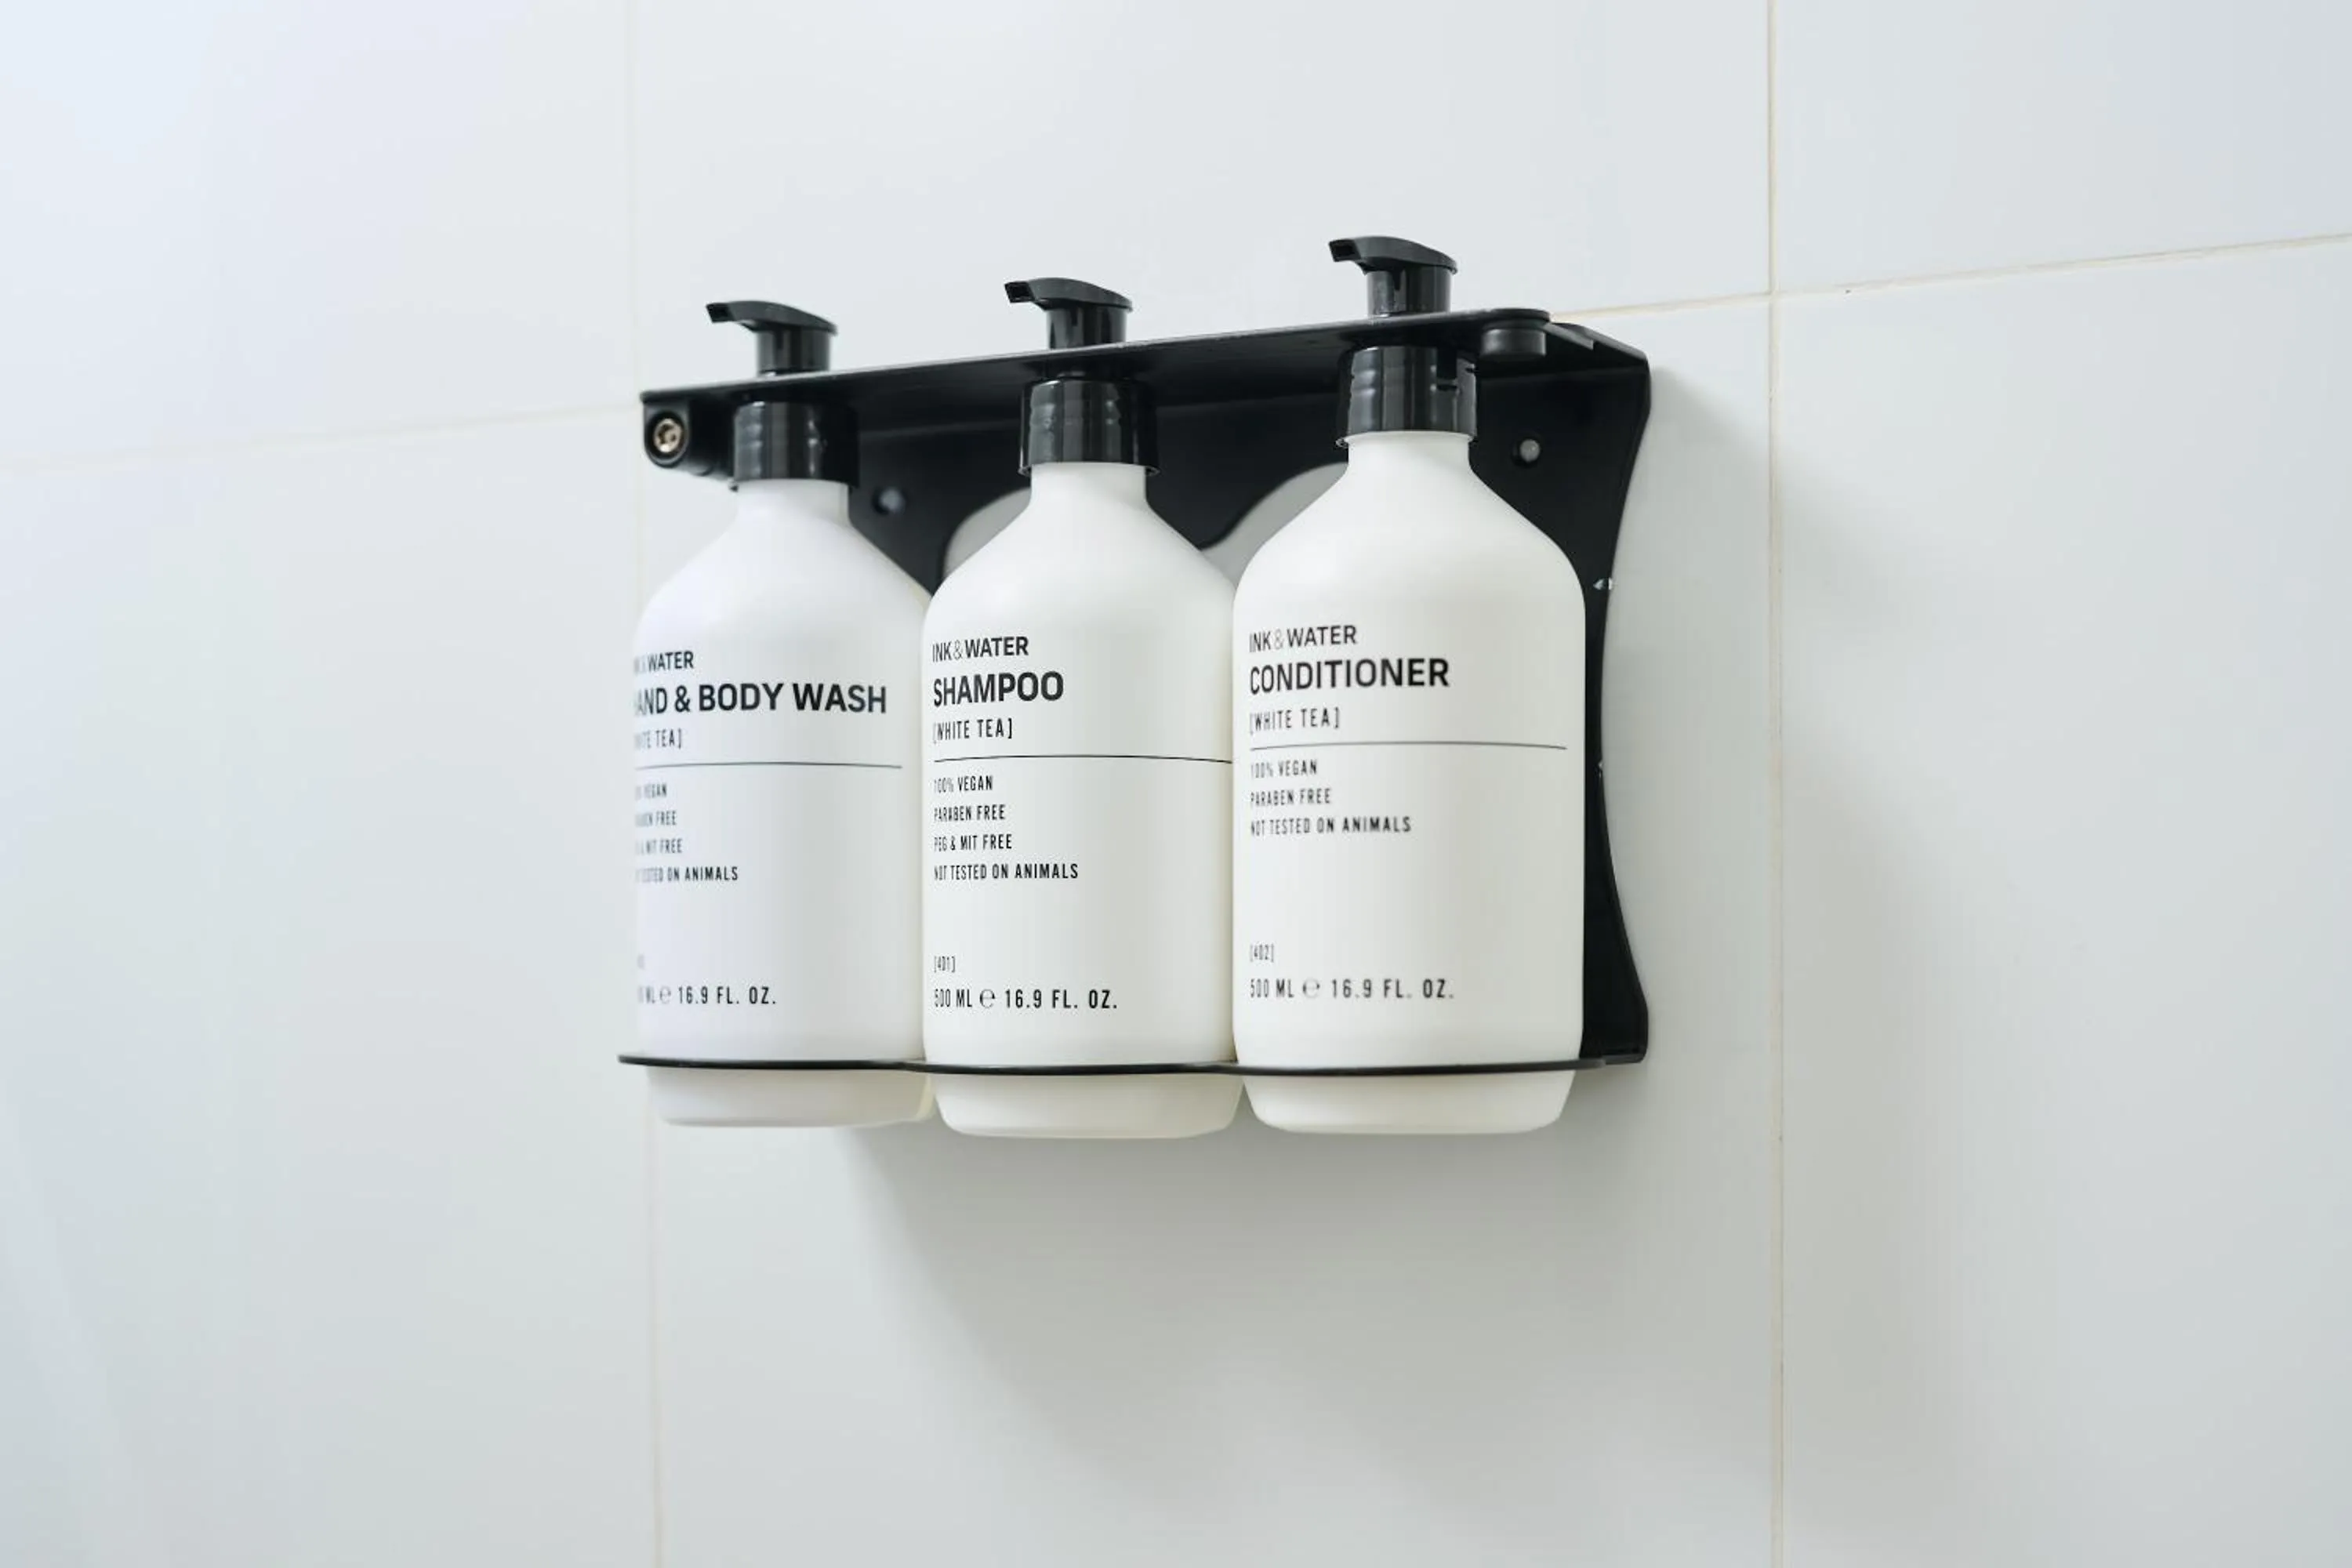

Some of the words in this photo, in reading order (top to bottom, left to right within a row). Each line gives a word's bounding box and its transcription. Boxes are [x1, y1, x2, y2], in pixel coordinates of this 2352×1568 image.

[1250, 658, 1450, 695] CONDITIONER
[933, 671, 1065, 707] SHAMPOO
[633, 688, 667, 716] AND
[674, 685, 691, 713] &
[699, 683, 784, 711] BODY
[793, 684, 887, 713] WASH
[1301, 706, 1339, 729] TEA]
[977, 717, 1012, 739] TEA]
[1277, 759, 1317, 777] VEGAN
[957, 775, 993, 792] VEGAN
[1250, 789, 1294, 807] PARABEN
[1299, 788, 1331, 804] FREE
[934, 805, 971, 822] PARABEN
[976, 804, 1006, 820] FREE
[1250, 820, 1265, 837] NOT
[1269, 818, 1311, 835] TESTED
[1317, 817, 1334, 833] ON
[1342, 815, 1412, 833] ANIMALS
[659, 837, 682, 853] FREE
[934, 836, 947, 852] PEG
[960, 835, 977, 851] MIT
[982, 833, 1012, 850] FREE
[667, 866, 680, 881] ON
[684, 866, 739, 880] ANIMALS
[934, 865, 947, 881] NOT
[950, 864, 986, 880] TESTED
[992, 863, 1008, 879] ON
[1014, 862, 1078, 879] ANIMALS
[678, 986, 708, 1004] 16.9
[717, 986, 739, 1004] FL.
[749, 985, 776, 1004] OZ.
[1250, 978, 1269, 998] 500
[1276, 978, 1294, 998] ML
[1332, 978, 1371, 998] 16.9
[1384, 978, 1412, 998] FL.
[1423, 978, 1454, 999] OZ.
[935, 989, 951, 1007] 500
[956, 989, 972, 1007] ML
[1005, 989, 1042, 1008] 16.9
[1052, 989, 1078, 1008] FL.
[1088, 989, 1117, 1008] OZ.
